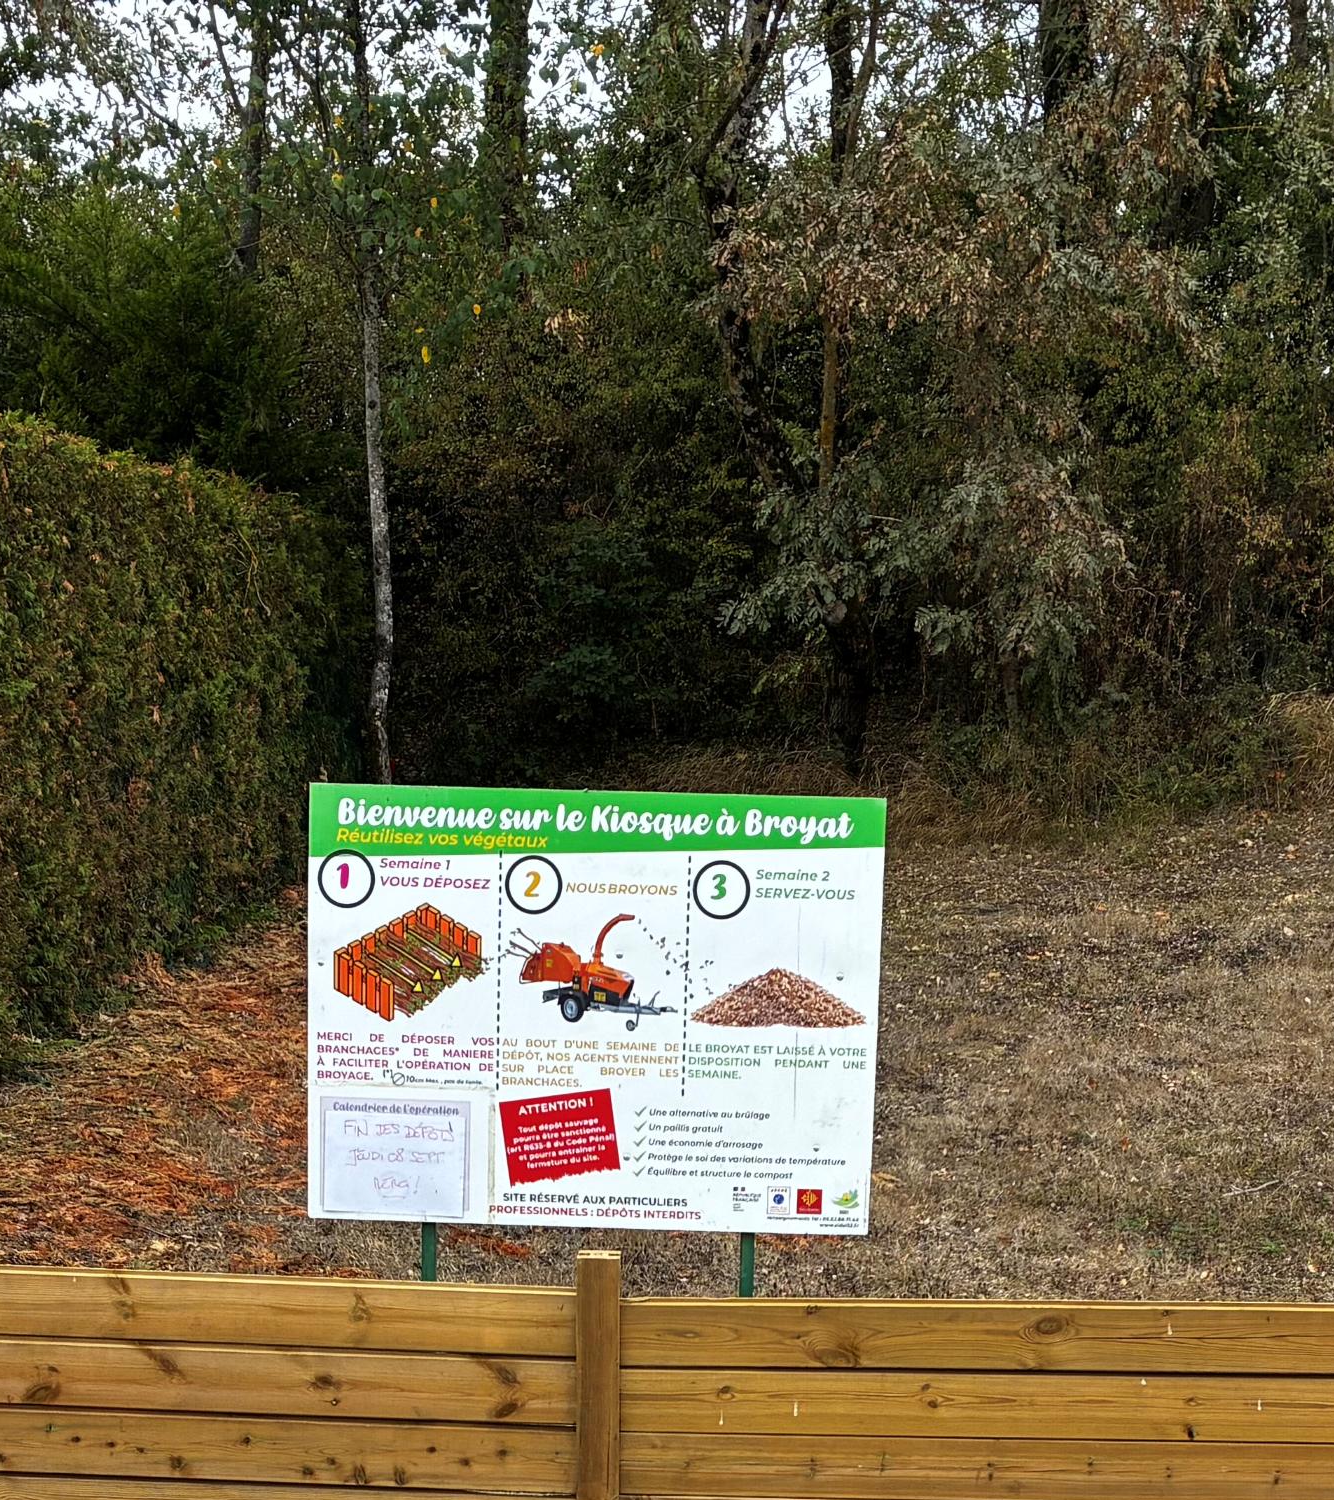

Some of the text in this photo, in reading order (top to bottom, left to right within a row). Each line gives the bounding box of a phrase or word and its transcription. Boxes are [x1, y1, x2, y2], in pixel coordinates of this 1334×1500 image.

[337, 798, 854, 844] Bienvenue sur le Kiosque à Broyat
[336, 828, 548, 849] Réutilisez vos végétaux
[380, 857, 450, 870] Semaine 1
[337, 863, 350, 889] 1
[380, 875, 491, 889] VOUS DÉPOSEZ
[756, 869, 830, 881] Semaine 2
[524, 871, 541, 897] 2
[566, 882, 678, 896] NOUS BROYONS
[711, 873, 728, 900] 3
[755, 887, 855, 900] SERVEZ-VOUS
[317, 1032, 495, 1046] MERCI DE DÉPOSER VOS
[502, 1039, 679, 1052] AU BOUT D'UNE SEMAINE DE
[414, 1048, 429, 1057] DE
[443, 1049, 494, 1059] MANIERE
[689, 1044, 867, 1056] LE BROYAT EST LAISSÉ À VOTRE
[317, 1055, 494, 1072] À FACILITER L'OPÉRATION DE
[547, 1053, 570, 1061] NOS
[574, 1053, 619, 1063] AGENTS
[623, 1055, 679, 1064] VIENNENT
[689, 1057, 866, 1069] DISPOSITION PENDANT UNE
[317, 1071, 373, 1081] BROYAGE.
[502, 1064, 679, 1077] SUR PLACE BROYER LES
[688, 1070, 741, 1079] SEMAINE.
[502, 1077, 582, 1087] BRANCHAGES.
[333, 1102, 459, 1116] Calendrier de l'opération
[519, 1098, 586, 1116] ATTENTION
[649, 1109, 667, 1117] Une
[669, 1109, 718, 1118] alternative
[735, 1110, 770, 1121] brûlage
[344, 1120, 368, 1137] FIN
[376, 1123, 400, 1136] DES
[518, 1118, 598, 1133] Tout dépôt sauvage
[649, 1123, 723, 1134] Un paillis gratuit
[513, 1126, 606, 1144] pourra être sanctionné
[554, 1140, 564, 1148] du
[649, 1138, 763, 1150] Une économie d'arrosage
[387, 1148, 404, 1162] 08
[527, 1159, 568, 1169] fermeture
[583, 1154, 600, 1162] site.
[529, 1150, 556, 1161] pourra
[648, 1153, 683, 1163] Protège
[685, 1154, 693, 1162] le
[710, 1154, 726, 1163] des
[728, 1156, 773, 1164] variations
[775, 1157, 786, 1165] de
[789, 1157, 846, 1167] température
[648, 1167, 793, 1181] Équilibre et structure le compost
[503, 1193, 687, 1207] SITE RÉSERVÉ AUX PARTICULIERS
[490, 1205, 588, 1216] PROFESSIONNELS
[597, 1207, 641, 1218] DÉPÔTS
[644, 1210, 701, 1220] INTERDITS
